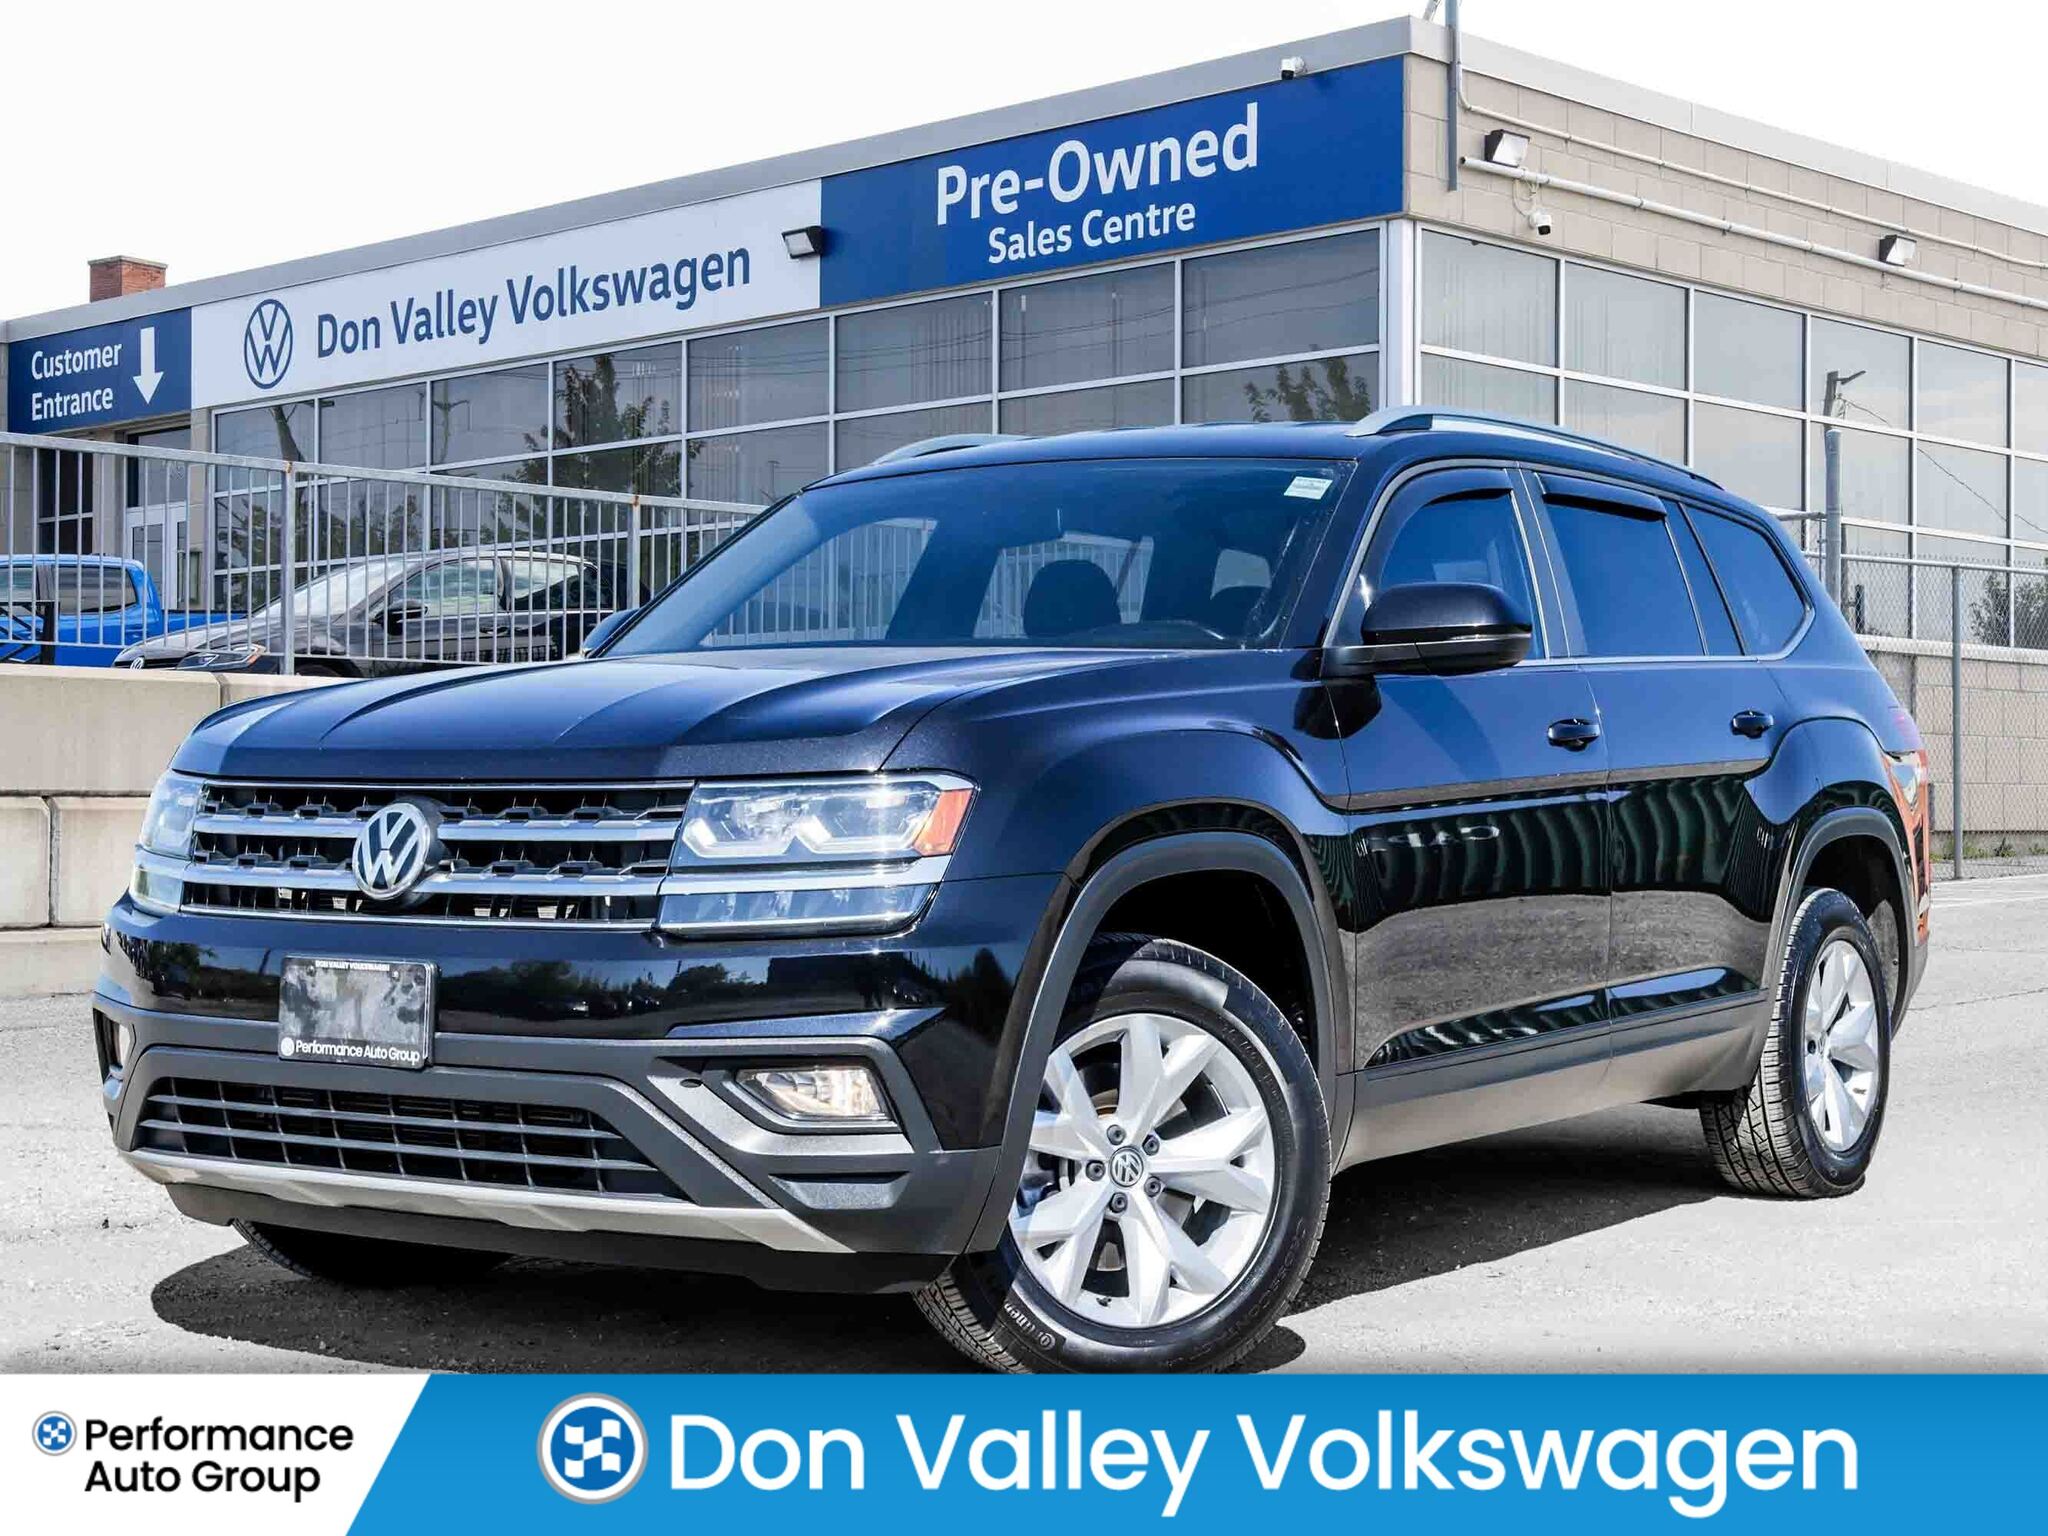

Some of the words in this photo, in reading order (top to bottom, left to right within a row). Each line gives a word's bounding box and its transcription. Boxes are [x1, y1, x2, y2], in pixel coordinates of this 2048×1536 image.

[937, 102, 1258, 225] Pre-Owned
[988, 220, 1073, 264] Sales
[1082, 203, 1196, 247] Centre
[317, 312, 381, 359] Don
[390, 288, 499, 345] Valley
[505, 246, 751, 325] Volkswagen
[31, 342, 122, 380] Customer
[31, 387, 113, 421] Entrance
[295, 1039, 364, 1058] Performance
[363, 1044, 388, 1060] Auto
[388, 1047, 421, 1066] Group
